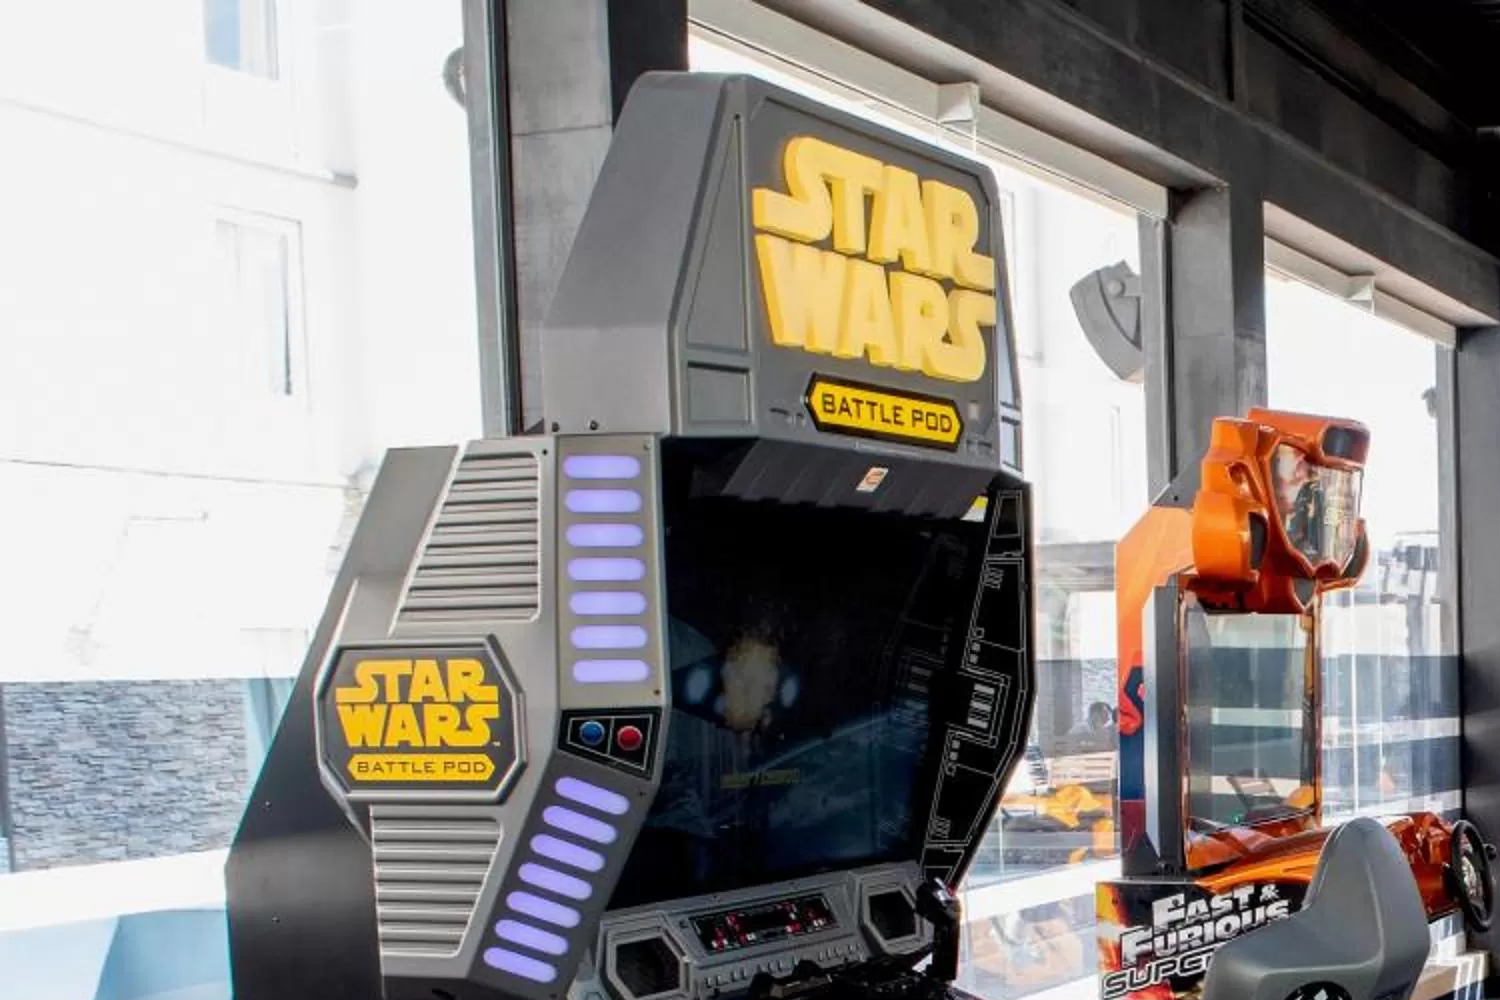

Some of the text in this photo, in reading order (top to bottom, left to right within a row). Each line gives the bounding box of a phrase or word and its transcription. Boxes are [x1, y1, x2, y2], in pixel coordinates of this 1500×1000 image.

[753, 136, 996, 290] STAR
[755, 233, 996, 383] WARS
[821, 393, 953, 434] BATTLE POD
[335, 659, 499, 703] STAR
[335, 703, 499, 747] WARS
[357, 760, 487, 773] BATTLE POD
[1152, 883, 1280, 933] FAST &
[1120, 899, 1290, 969] FURIOUS
